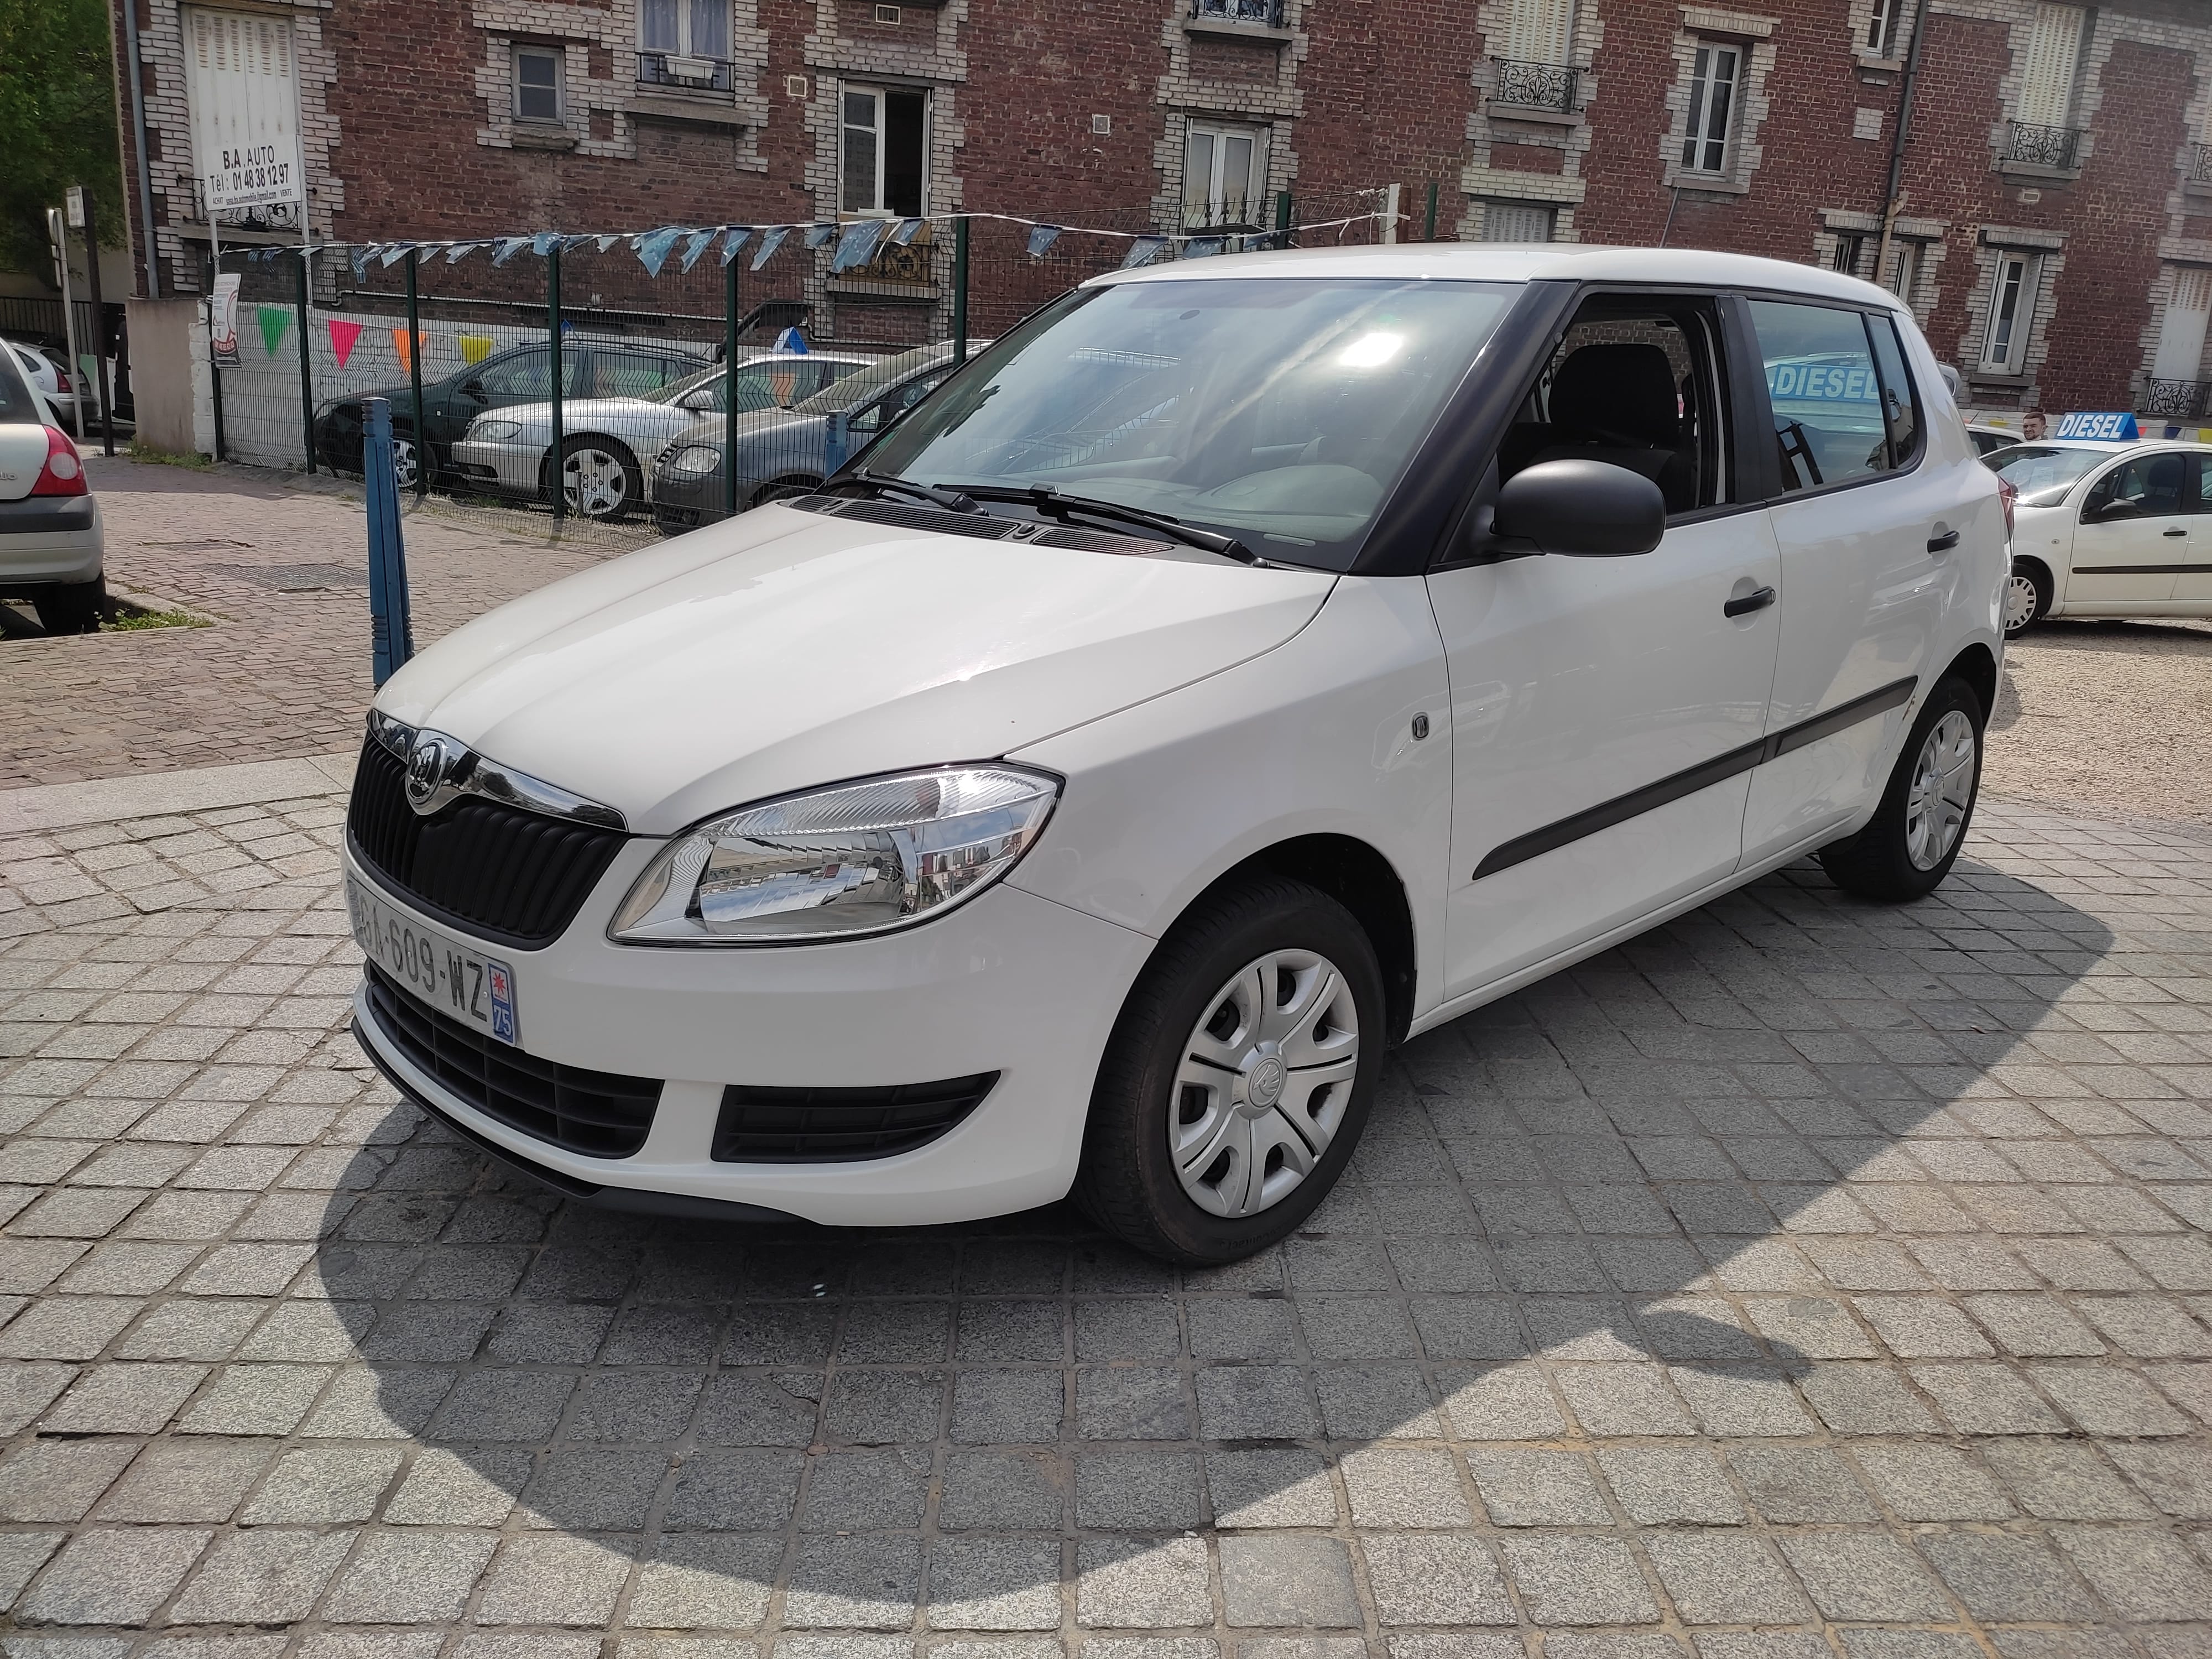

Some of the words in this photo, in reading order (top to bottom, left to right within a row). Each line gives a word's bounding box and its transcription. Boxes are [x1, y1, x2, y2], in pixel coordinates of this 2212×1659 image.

[232, 170, 242, 191] 01
[244, 169, 254, 189] 48
[255, 167, 266, 188] 38
[267, 165, 278, 186] 12
[279, 163, 289, 184] 97
[280, 189, 293, 197] VENTE
[1775, 366, 1879, 399] DIESEL
[2057, 415, 2124, 439] DIESEL
[494, 1004, 512, 1036] 75
